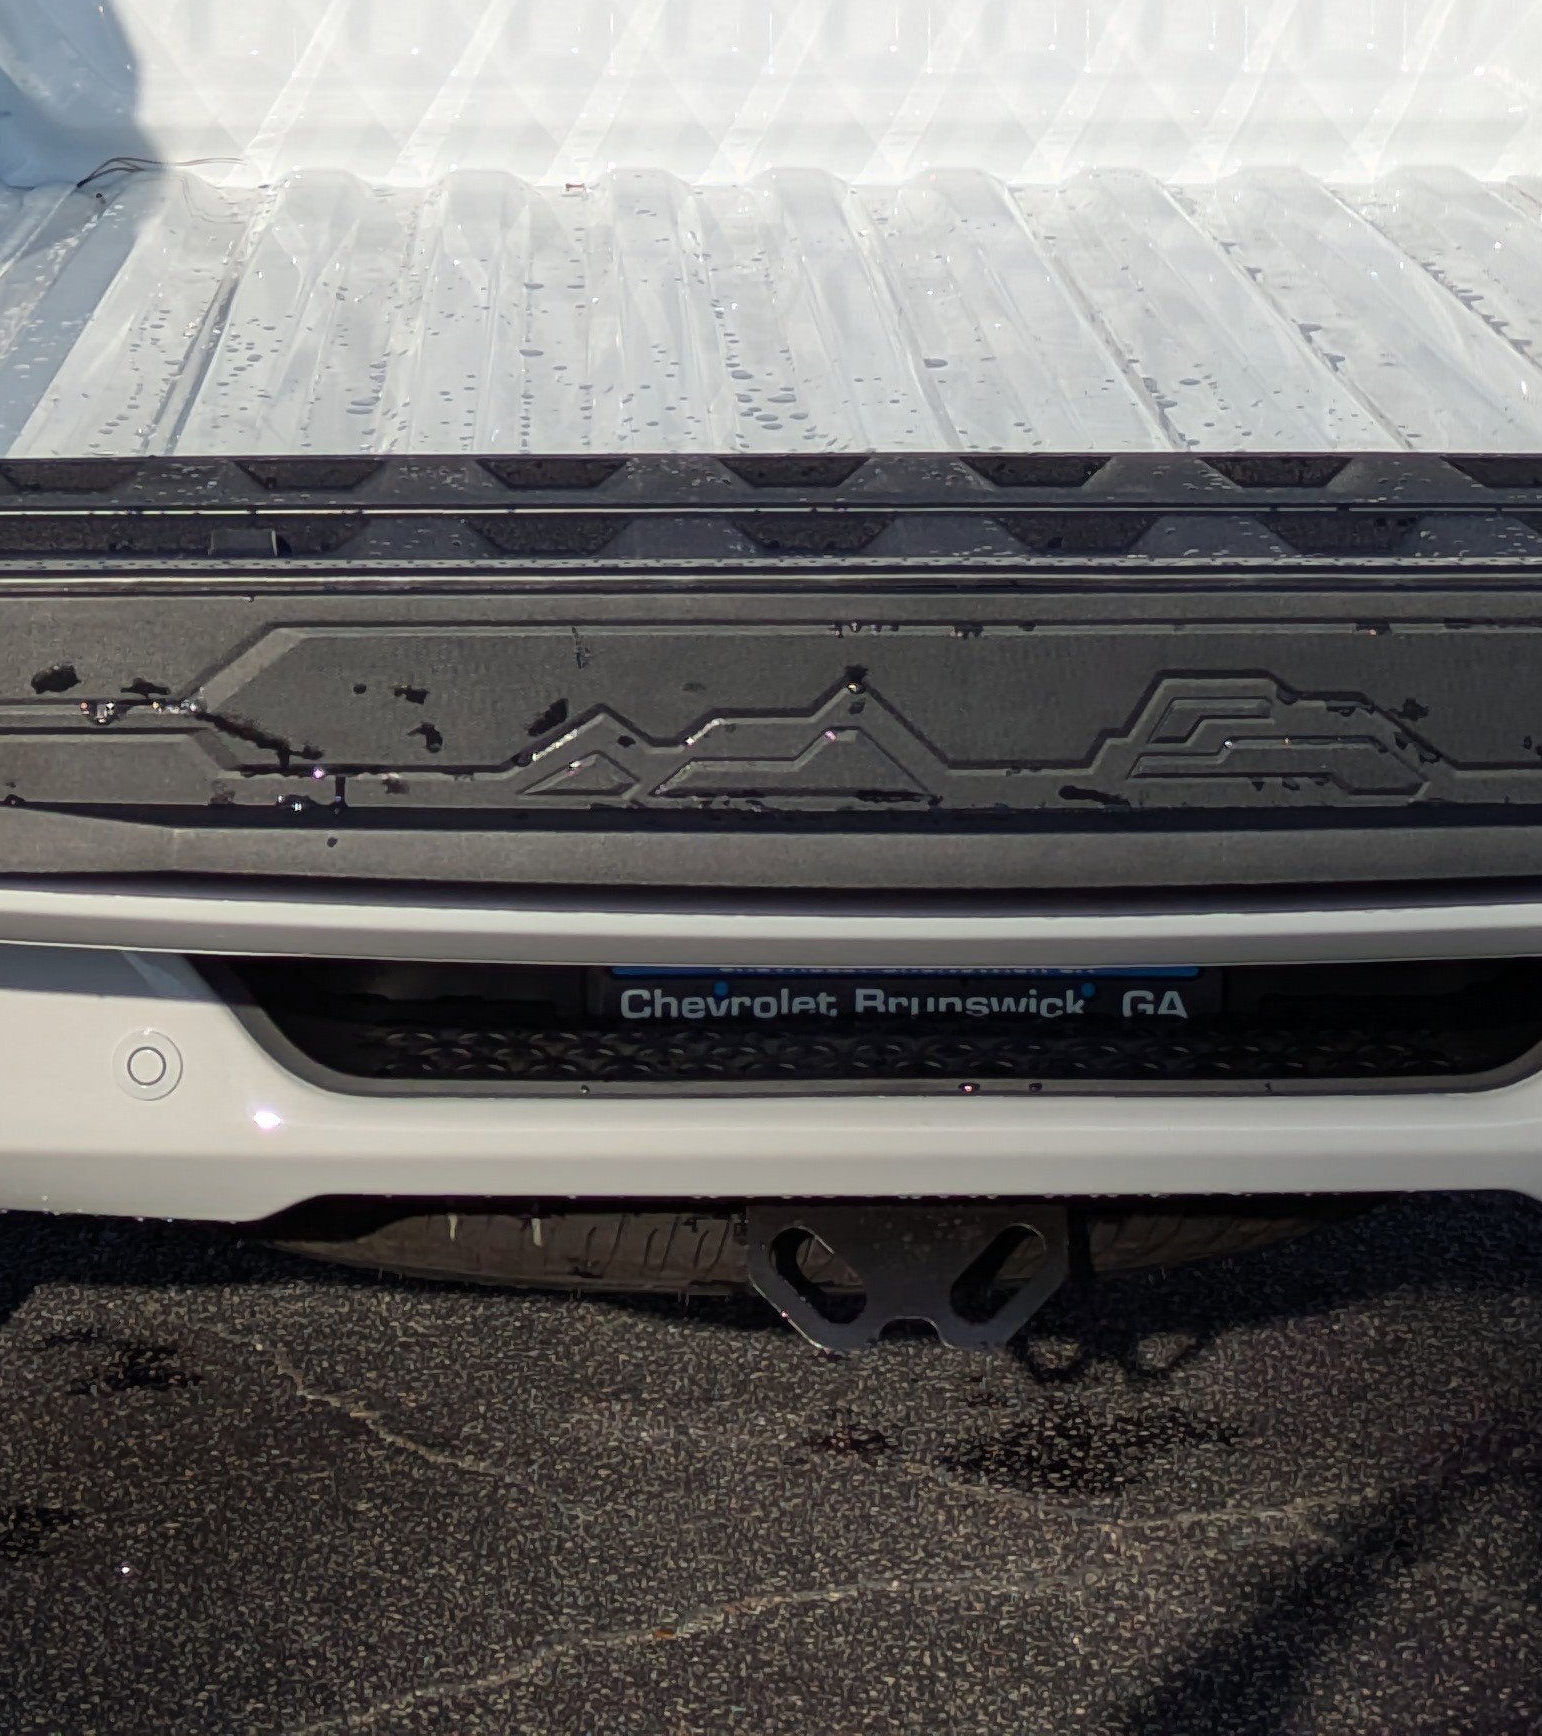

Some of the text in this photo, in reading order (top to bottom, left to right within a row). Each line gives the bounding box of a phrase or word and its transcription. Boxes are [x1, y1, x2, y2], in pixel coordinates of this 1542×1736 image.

[619, 987, 1190, 1020] Chevrolet Brunswick GA
